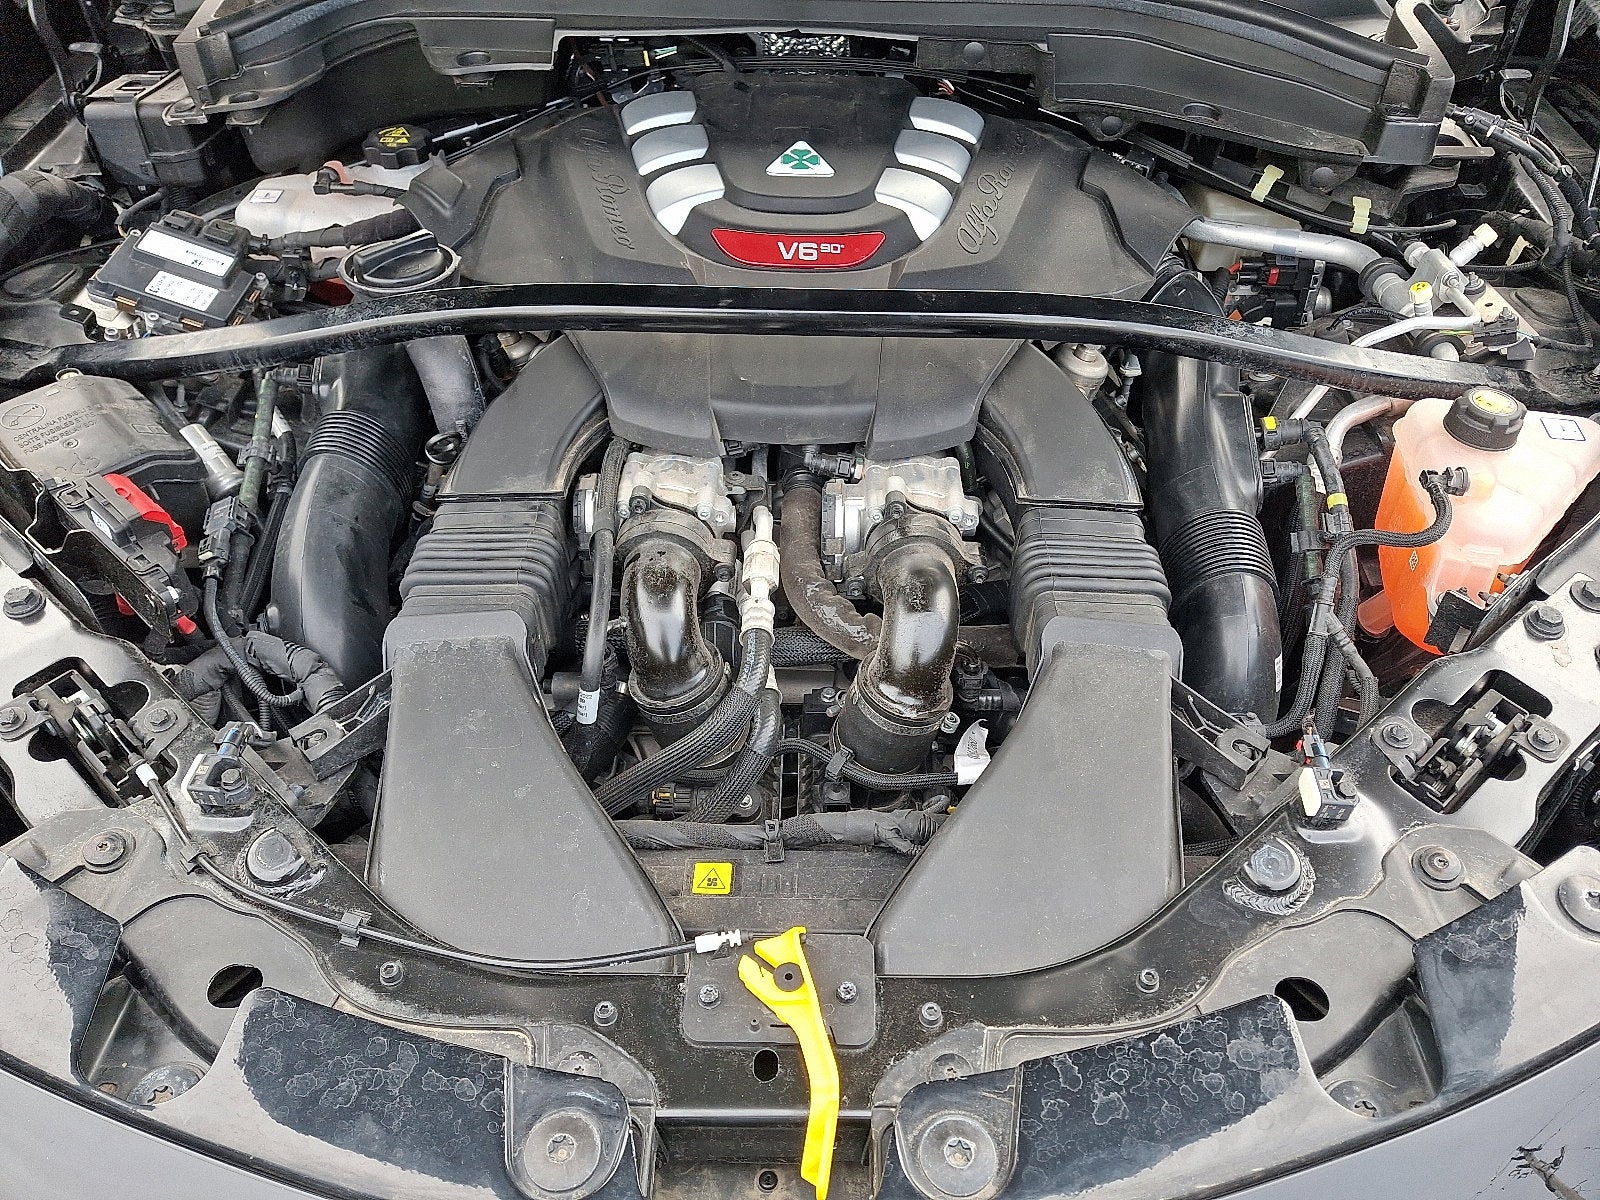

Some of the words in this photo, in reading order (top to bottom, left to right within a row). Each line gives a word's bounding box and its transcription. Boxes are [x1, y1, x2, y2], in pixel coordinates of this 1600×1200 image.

[957, 201, 999, 254] Alfa
[777, 241, 818, 261] V6
[13, 419, 58, 442] CENTRALINA
[24, 442, 44, 456] FUSE
[44, 435, 60, 446] AND
